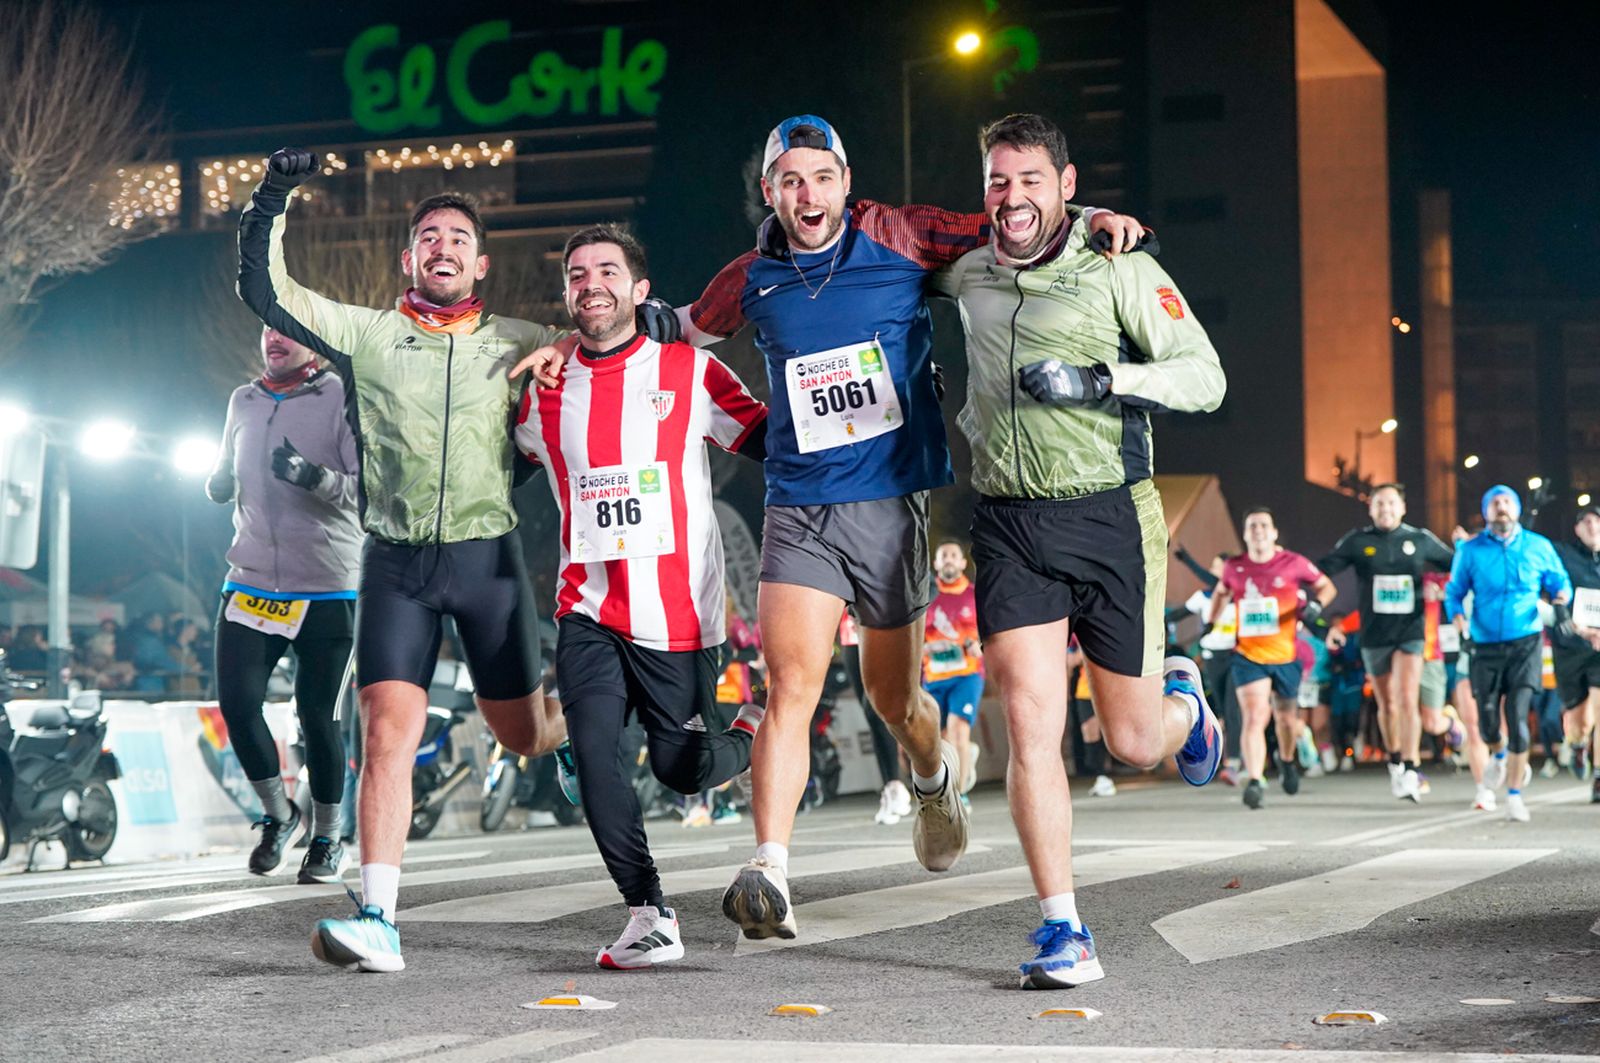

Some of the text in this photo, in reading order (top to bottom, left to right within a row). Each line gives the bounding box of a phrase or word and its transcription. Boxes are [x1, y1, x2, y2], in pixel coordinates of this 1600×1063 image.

[343, 20, 668, 133] El Corte
[808, 360, 837, 375] NOCHE
[838, 358, 850, 369] DE
[799, 376, 819, 390] SAN
[810, 377, 878, 417] 5061
[588, 476, 616, 488] NOCHE
[617, 475, 629, 485] DE
[580, 489, 597, 501] SAN
[596, 497, 642, 529] 816
